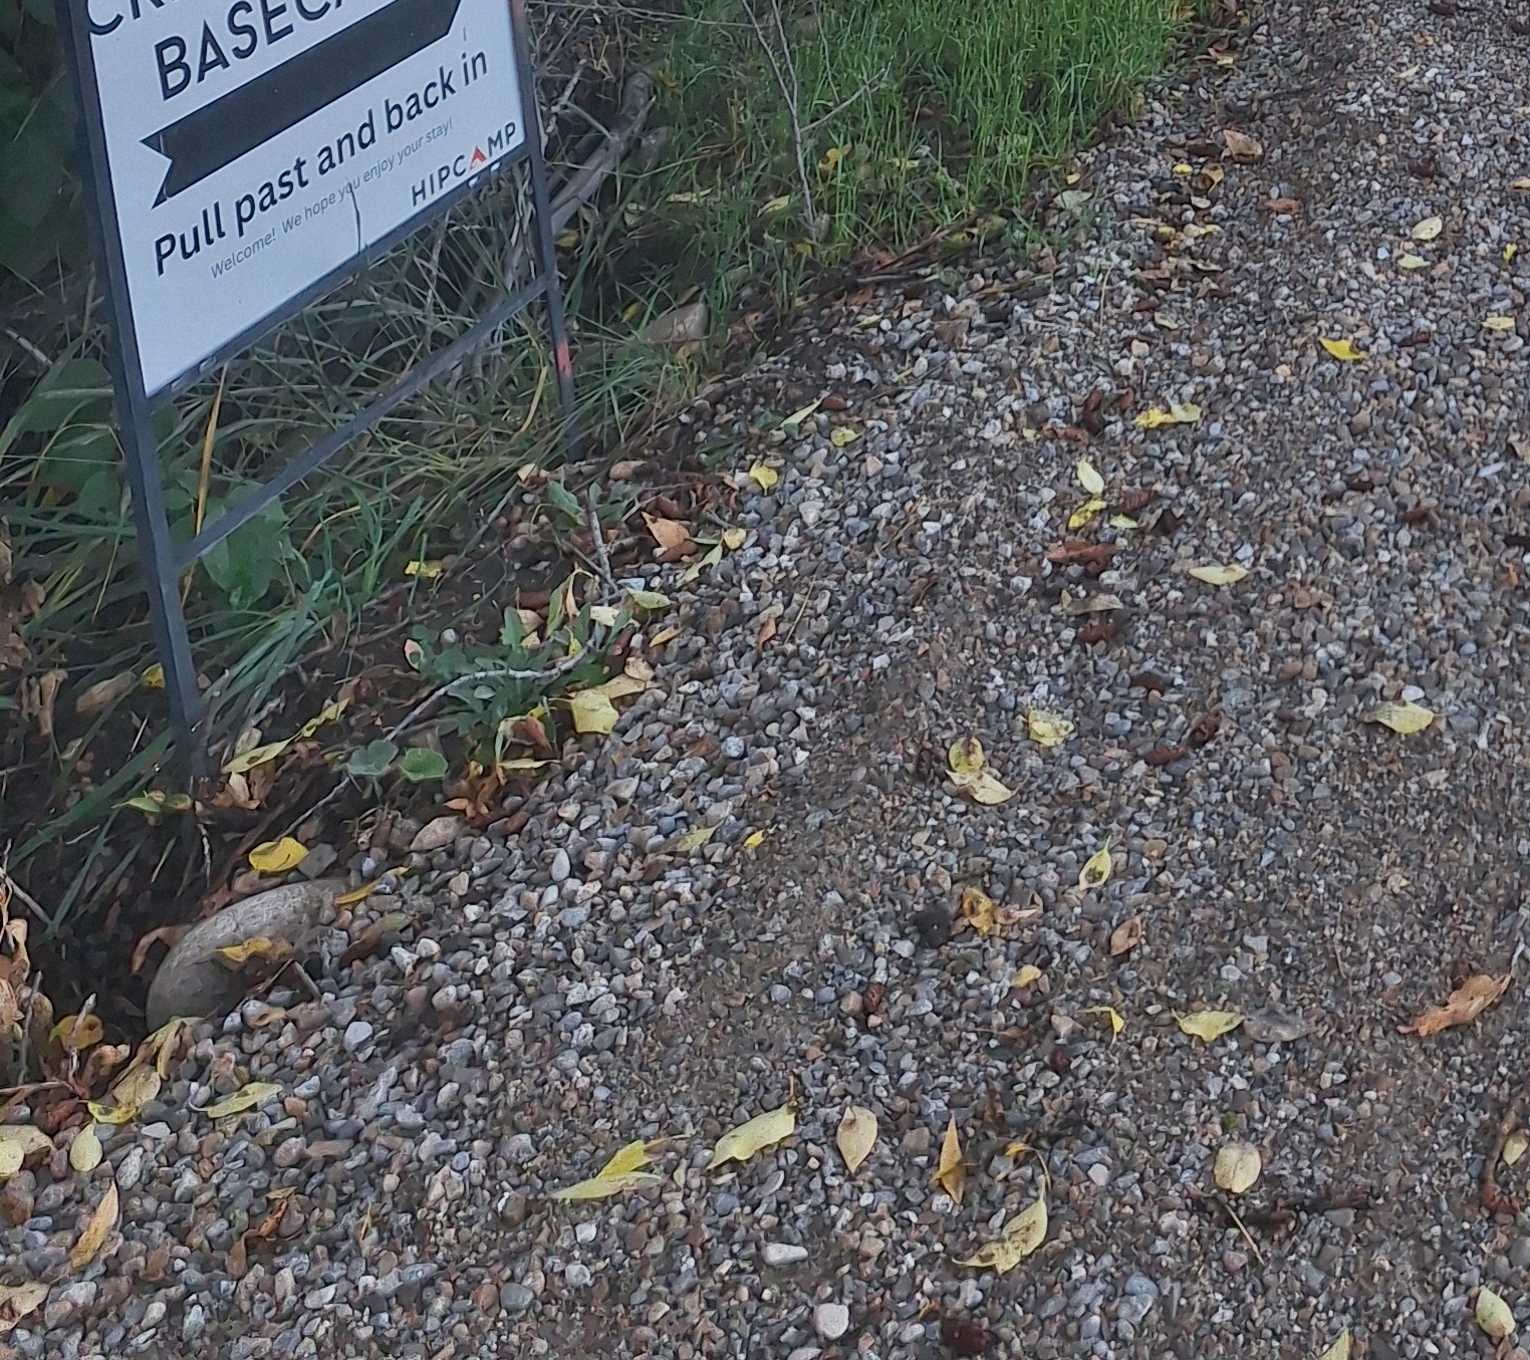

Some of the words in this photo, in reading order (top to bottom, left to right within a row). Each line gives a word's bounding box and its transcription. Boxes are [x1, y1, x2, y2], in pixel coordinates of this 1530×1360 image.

[154, 198, 226, 276] Pull
[235, 156, 309, 238] past
[318, 109, 376, 176] and
[384, 66, 456, 133] back
[462, 49, 488, 87] in
[210, 227, 276, 278] Welcome!
[281, 214, 302, 234] We
[304, 192, 336, 221] hope
[338, 179, 361, 202] you
[363, 154, 395, 183] enjoy
[398, 136, 425, 165] your
[425, 117, 452, 144] stay!
[412, 122, 516, 206] HIPCAMP
